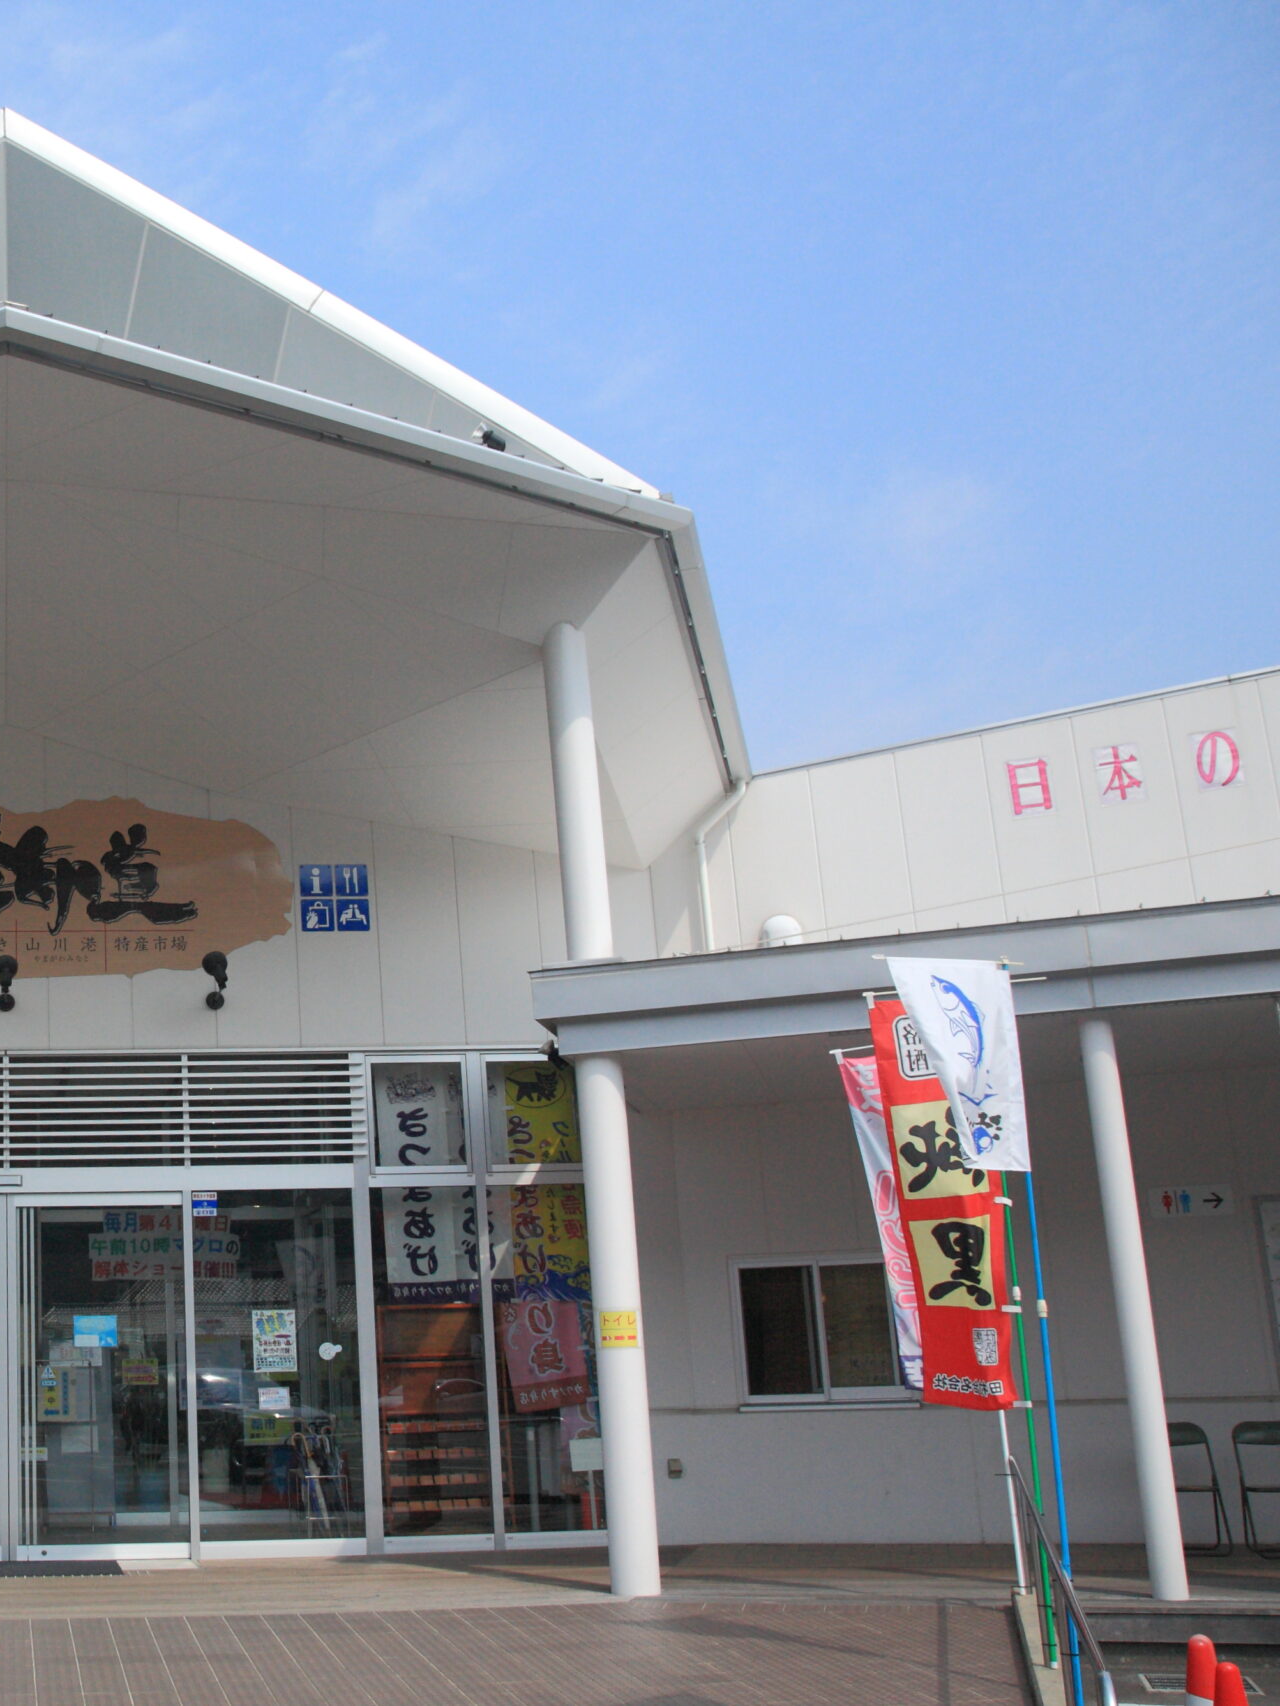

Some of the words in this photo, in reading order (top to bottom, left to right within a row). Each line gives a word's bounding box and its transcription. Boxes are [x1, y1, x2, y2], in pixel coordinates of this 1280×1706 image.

[1007, 731, 1240, 815] 日本の
[25, 937, 97, 953] 山川港
[114, 936, 188, 952] 特産市場
[601, 1315, 637, 1327] トイレ
